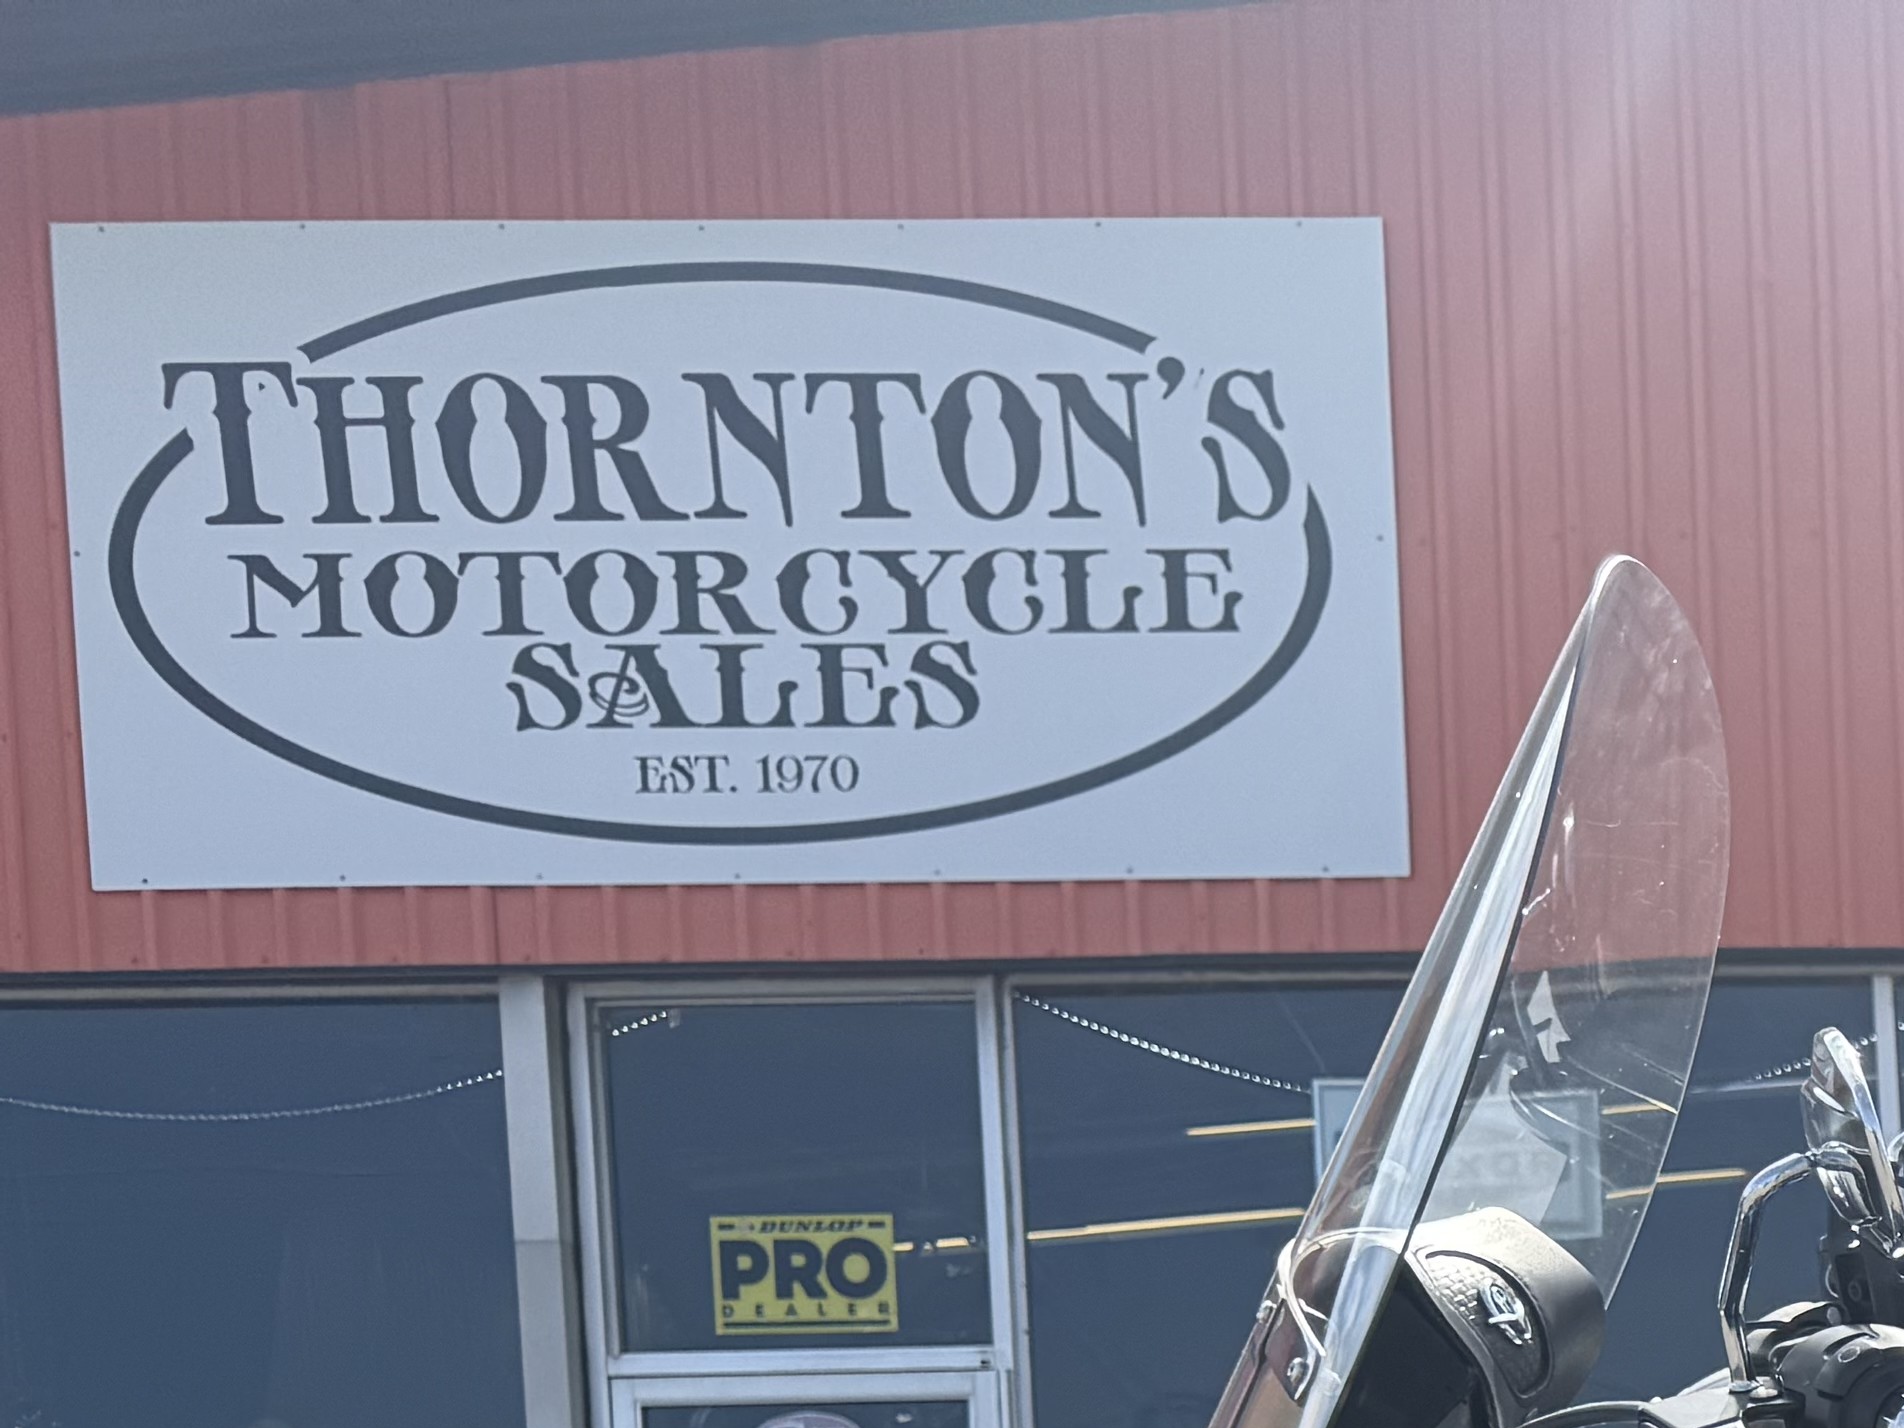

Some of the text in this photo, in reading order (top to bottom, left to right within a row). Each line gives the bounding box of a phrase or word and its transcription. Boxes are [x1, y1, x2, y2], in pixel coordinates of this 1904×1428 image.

[161, 355, 1291, 528] THORNTON'S
[228, 545, 1242, 640] MOTORCYCLE
[507, 638, 981, 732] SALES
[633, 751, 861, 794] EST. 1970
[759, 1219, 863, 1234] DUNLOP
[719, 1237, 888, 1300] PRO
[722, 1302, 890, 1318] DEALER
